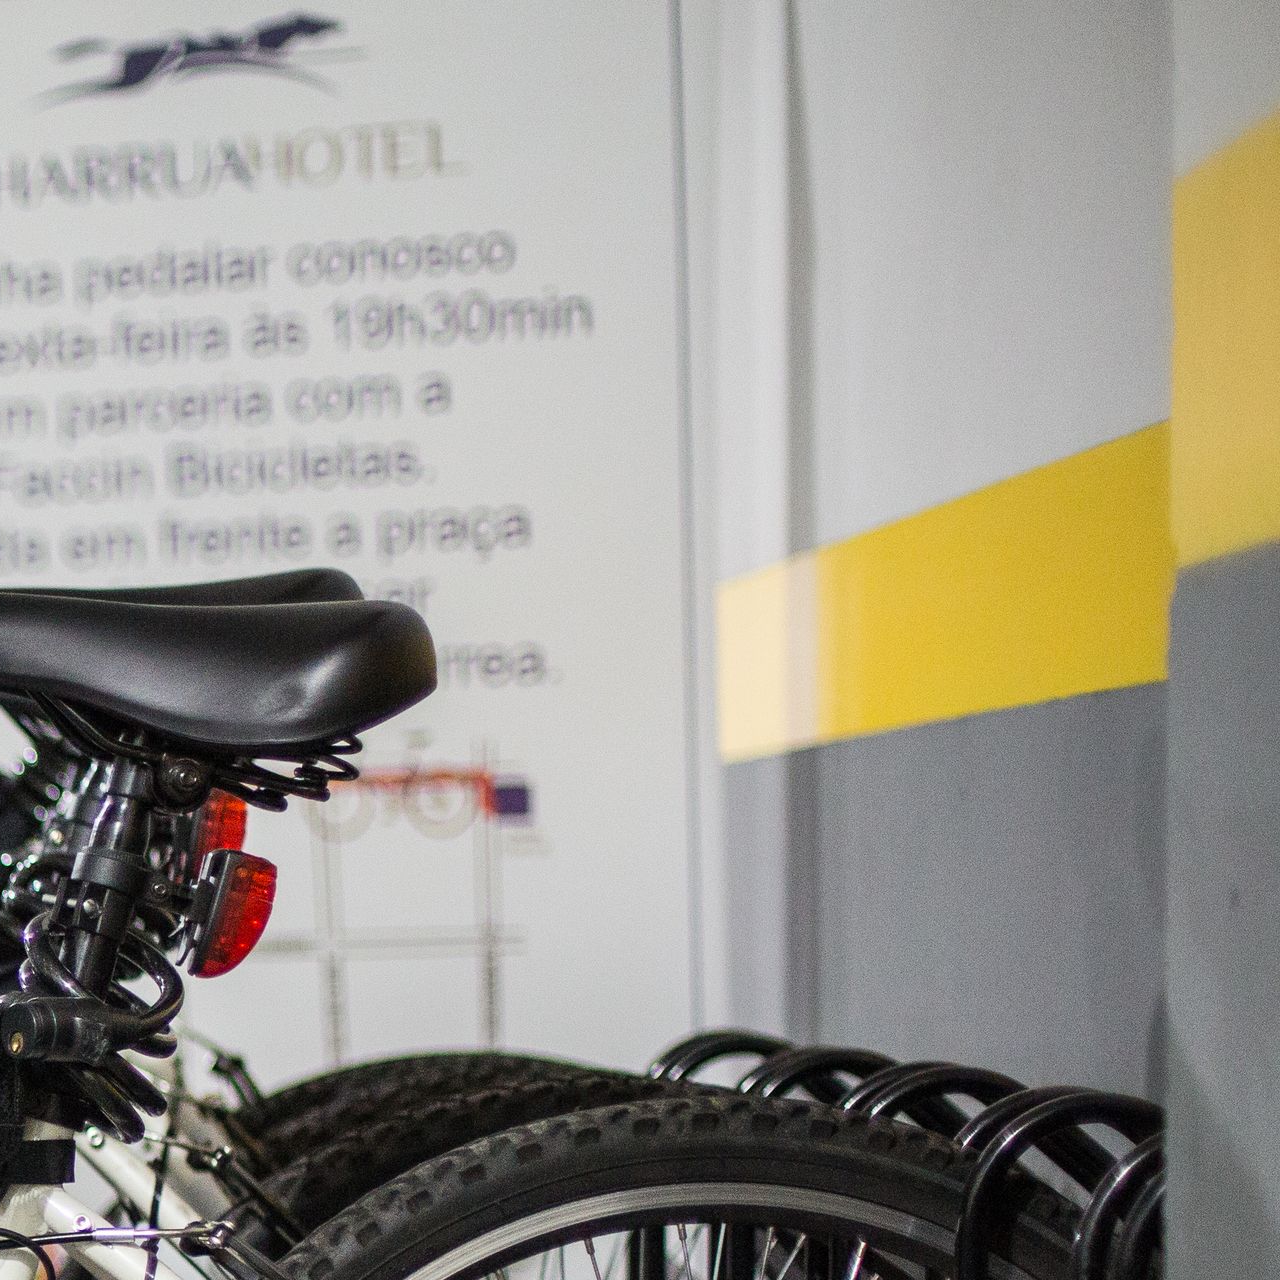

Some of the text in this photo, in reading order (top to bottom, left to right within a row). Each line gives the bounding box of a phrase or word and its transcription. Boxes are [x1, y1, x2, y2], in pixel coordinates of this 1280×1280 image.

[73, 246, 273, 310] pedalar
[288, 230, 517, 287] conosco
[329, 287, 595, 350] 19h30min
[56, 378, 273, 448] parceria
[283, 374, 400, 426] com
[415, 370, 452, 417] a
[58, 522, 148, 572] em
[155, 508, 310, 567] frente
[327, 510, 363, 558] a
[375, 504, 532, 566] praça
